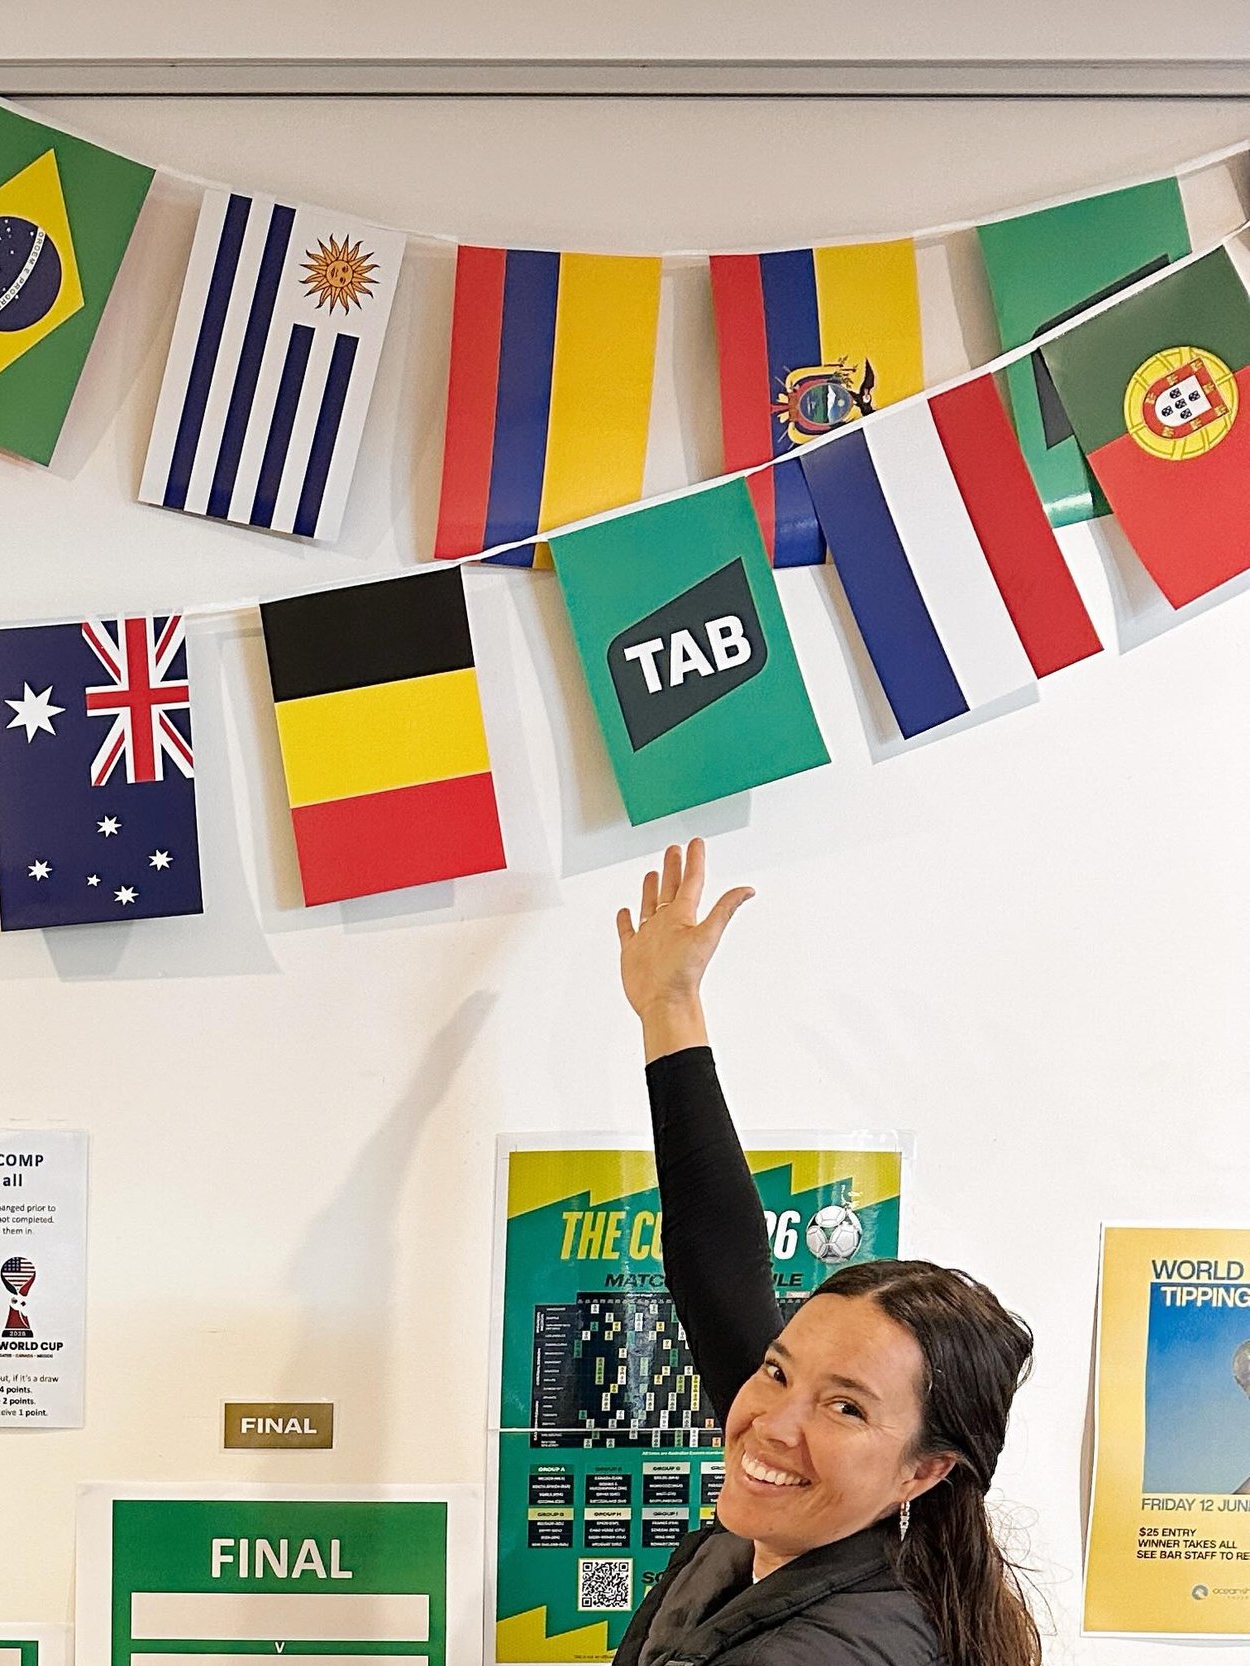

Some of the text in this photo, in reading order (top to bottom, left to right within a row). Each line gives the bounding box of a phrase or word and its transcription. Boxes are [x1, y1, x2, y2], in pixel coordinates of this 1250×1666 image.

[28, 232, 44, 265] ORDEM
[623, 615, 751, 694] TAB
[2, 1173, 22, 1187] all
[560, 1210, 626, 1260] THE
[1151, 1259, 1244, 1280] WORLD
[604, 1272, 666, 1288] MATC
[1160, 1286, 1250, 1308] TIPPING
[40, 1341, 63, 1351] CUP
[241, 1417, 317, 1434] FINAL
[1141, 1497, 1250, 1512] FRIDAY 12 JUN
[1138, 1526, 1196, 1537] $25 ENTRY
[1137, 1538, 1237, 1549] WINNER TAKES ALL
[211, 1538, 352, 1578] FINAL
[1136, 1549, 1157, 1558] SEE
[1159, 1550, 1182, 1559] BAR
[1184, 1550, 1217, 1560] STAFF
[1219, 1551, 1234, 1560] TO
